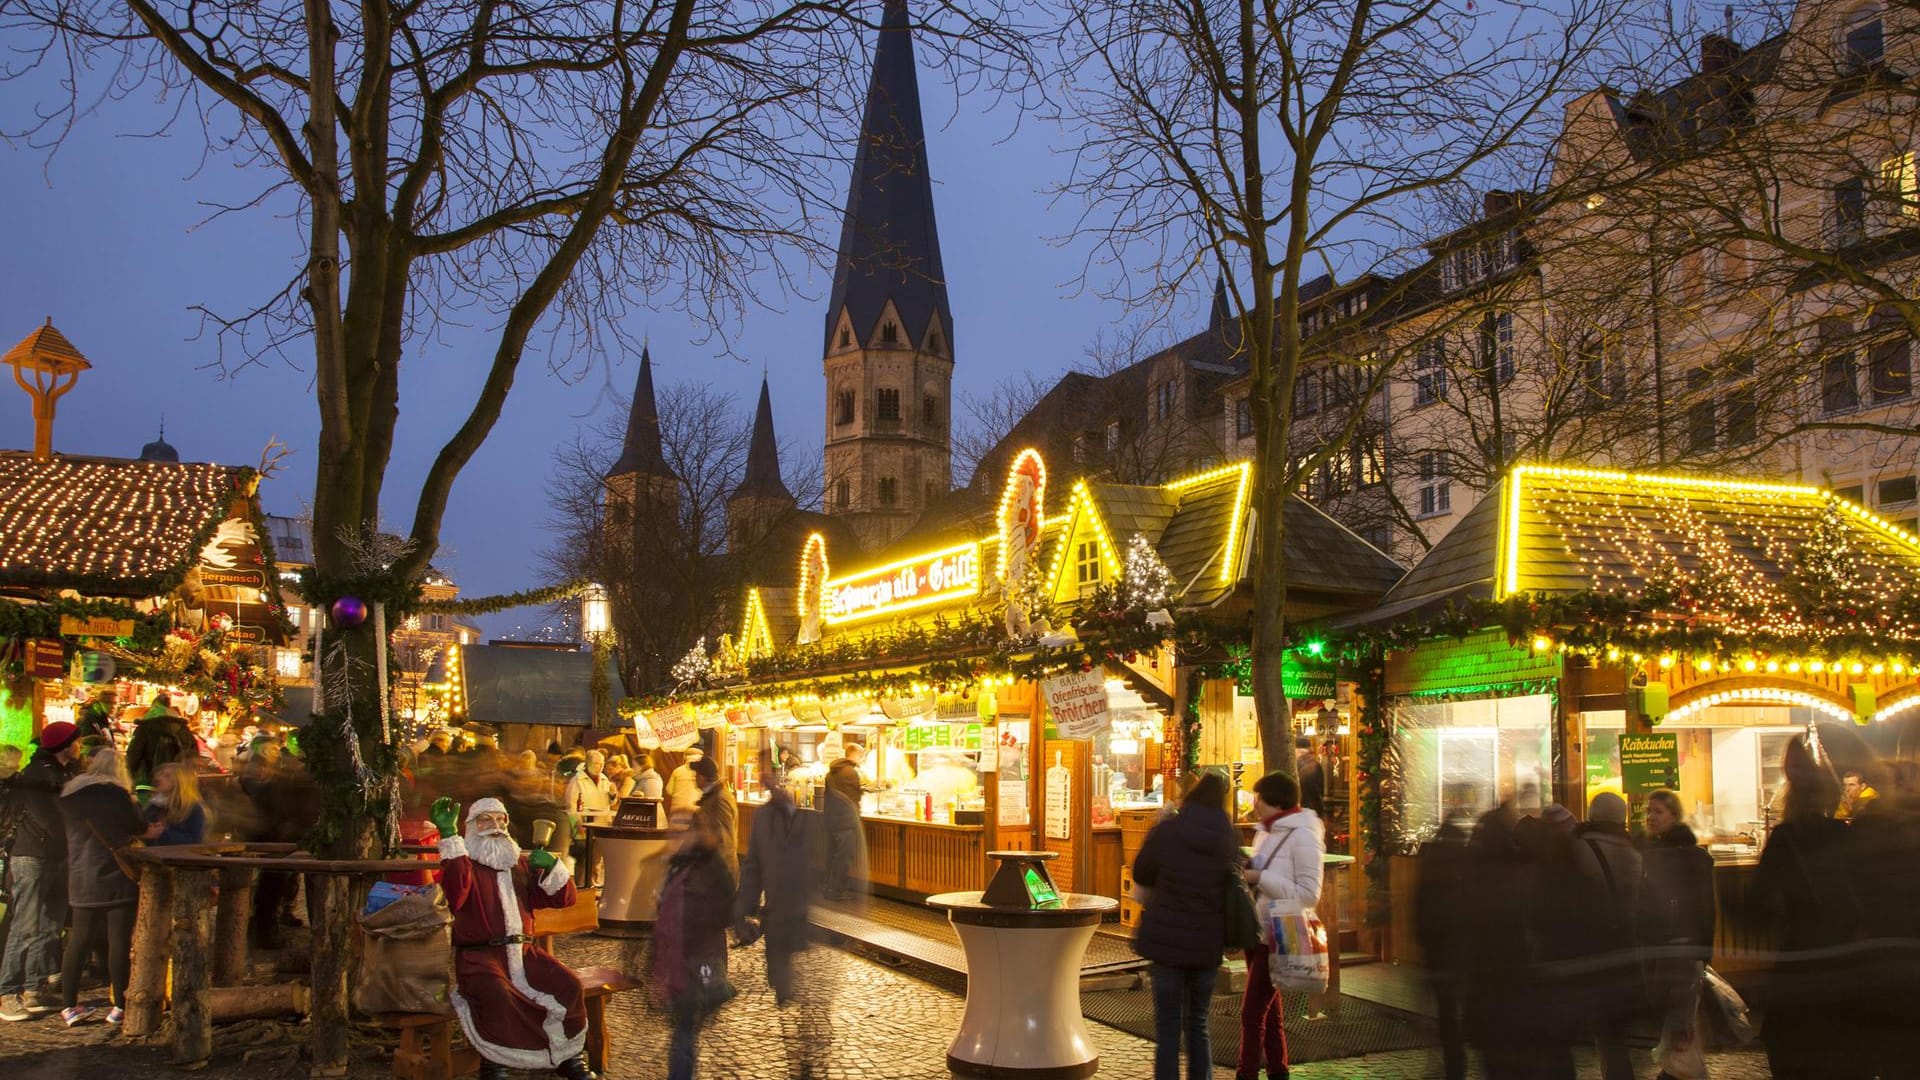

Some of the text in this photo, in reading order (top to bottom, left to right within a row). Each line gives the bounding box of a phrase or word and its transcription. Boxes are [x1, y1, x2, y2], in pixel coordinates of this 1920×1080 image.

[1052, 684, 1100, 704] Ofenfrische
[1052, 698, 1107, 724] Brötchen
[1622, 736, 1675, 751] Reibekuchen
